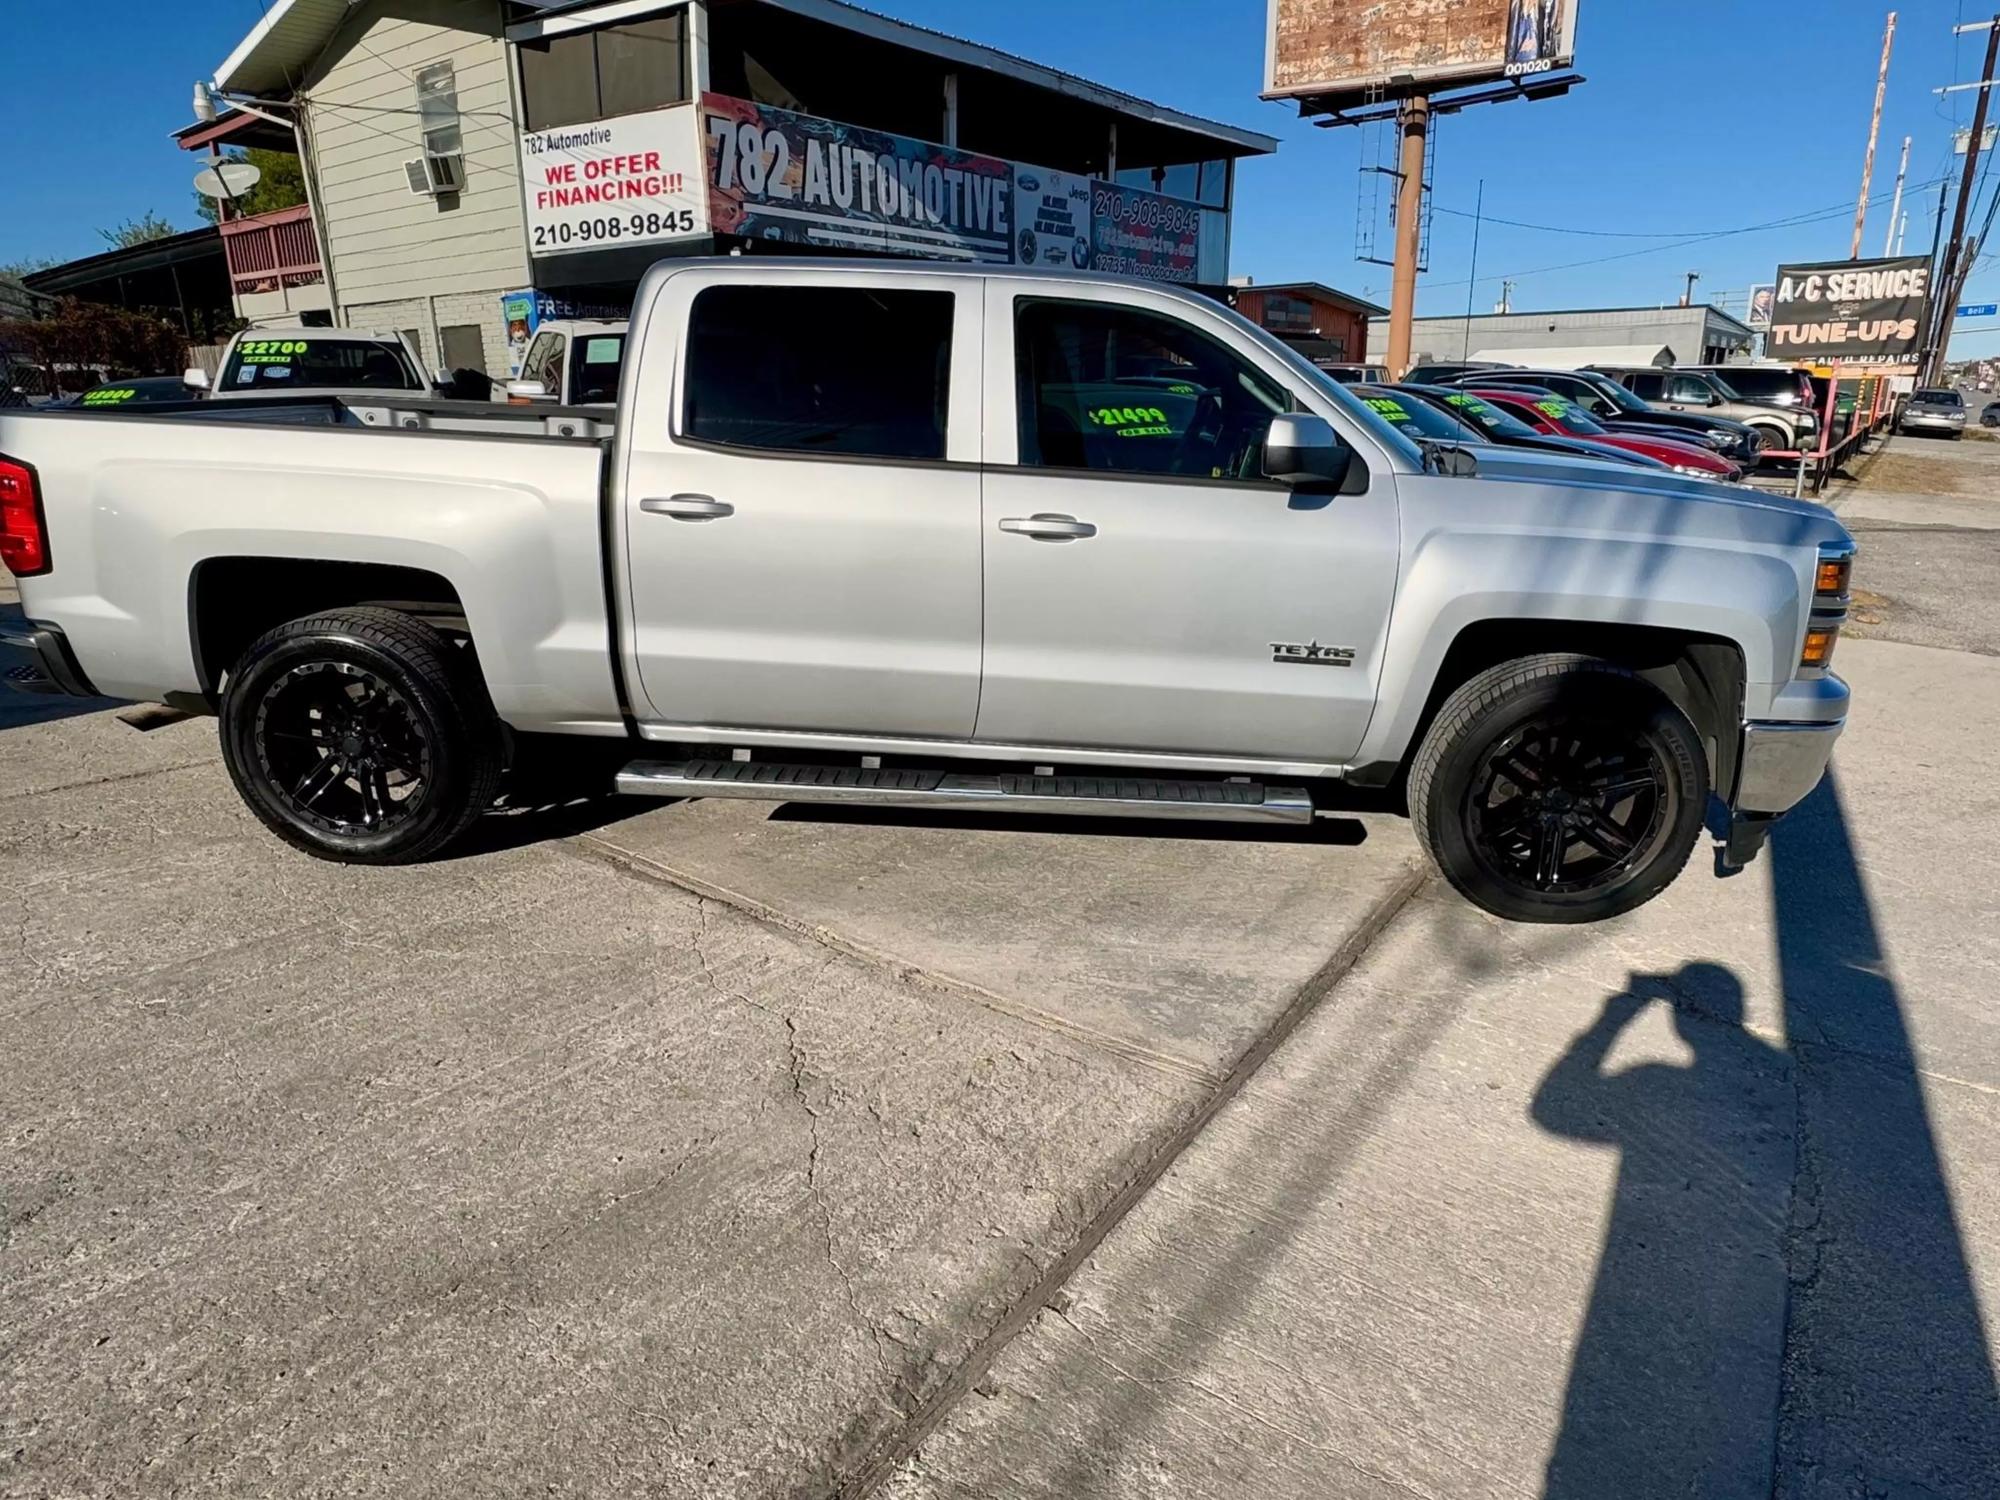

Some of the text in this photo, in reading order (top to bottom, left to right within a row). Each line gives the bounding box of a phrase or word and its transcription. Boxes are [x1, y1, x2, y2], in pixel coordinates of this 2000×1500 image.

[1505, 59, 1551, 75] 001020
[524, 126, 612, 155] 782 Automotive
[545, 151, 661, 185] WE OFFER
[707, 117, 1009, 234] 782 AUTOMOTIVE
[537, 173, 684, 210] FINANCING!!!
[1069, 184, 1089, 205] Jeep
[1094, 190, 1200, 235] 210-908-9845
[534, 209, 694, 247] 210-908-9845
[1777, 268, 1928, 304] A/C SERVICE
[537, 299, 574, 316] FREE
[1772, 318, 1917, 346] TUNE-UPS
[236, 341, 308, 355] $22700
[1089, 408, 1168, 426] $21499
